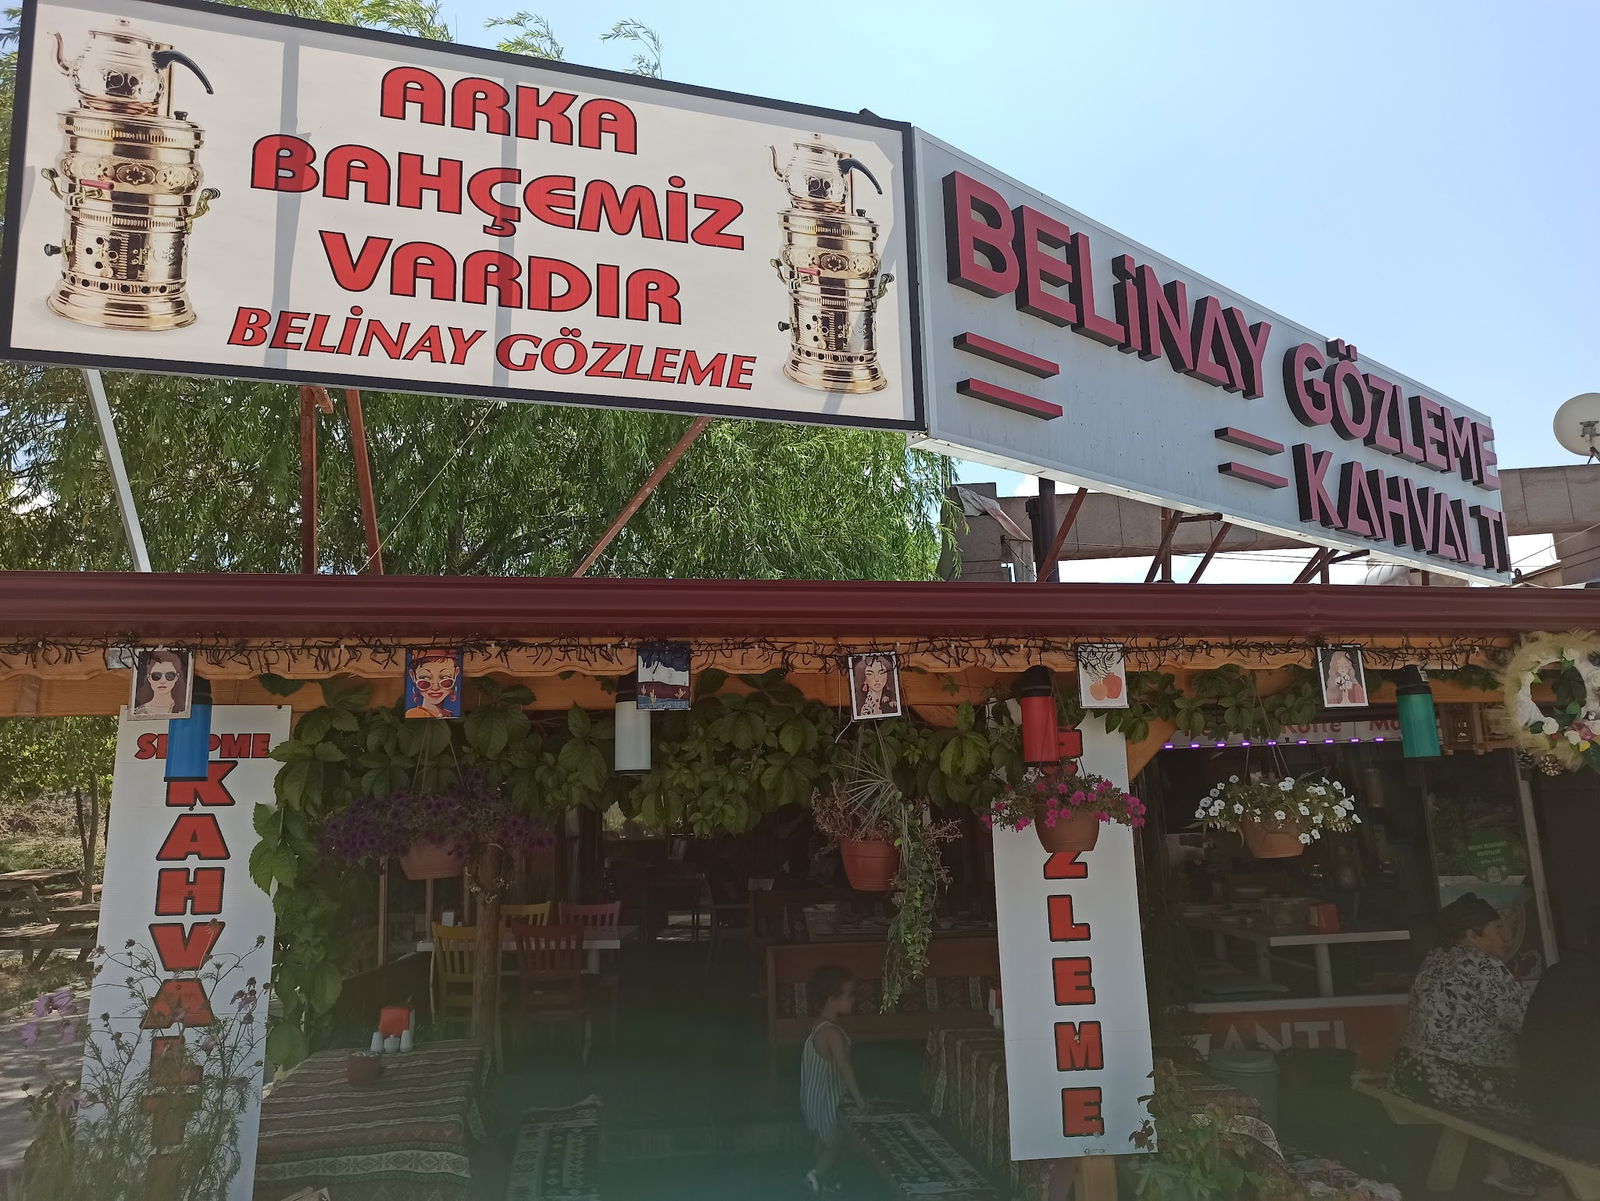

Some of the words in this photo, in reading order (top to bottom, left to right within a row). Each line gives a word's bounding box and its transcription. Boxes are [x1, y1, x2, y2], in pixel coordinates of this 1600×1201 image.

[380, 66, 638, 155] ARKA
[250, 134, 744, 250] BAHÇEMİZ
[318, 230, 682, 325] VARDIR
[227, 305, 487, 366] BELİNAY
[496, 327, 757, 390] GÖZLEME
[1283, 338, 1499, 491] GÖZLEME
[1292, 442, 1511, 573] KAHVALTI
